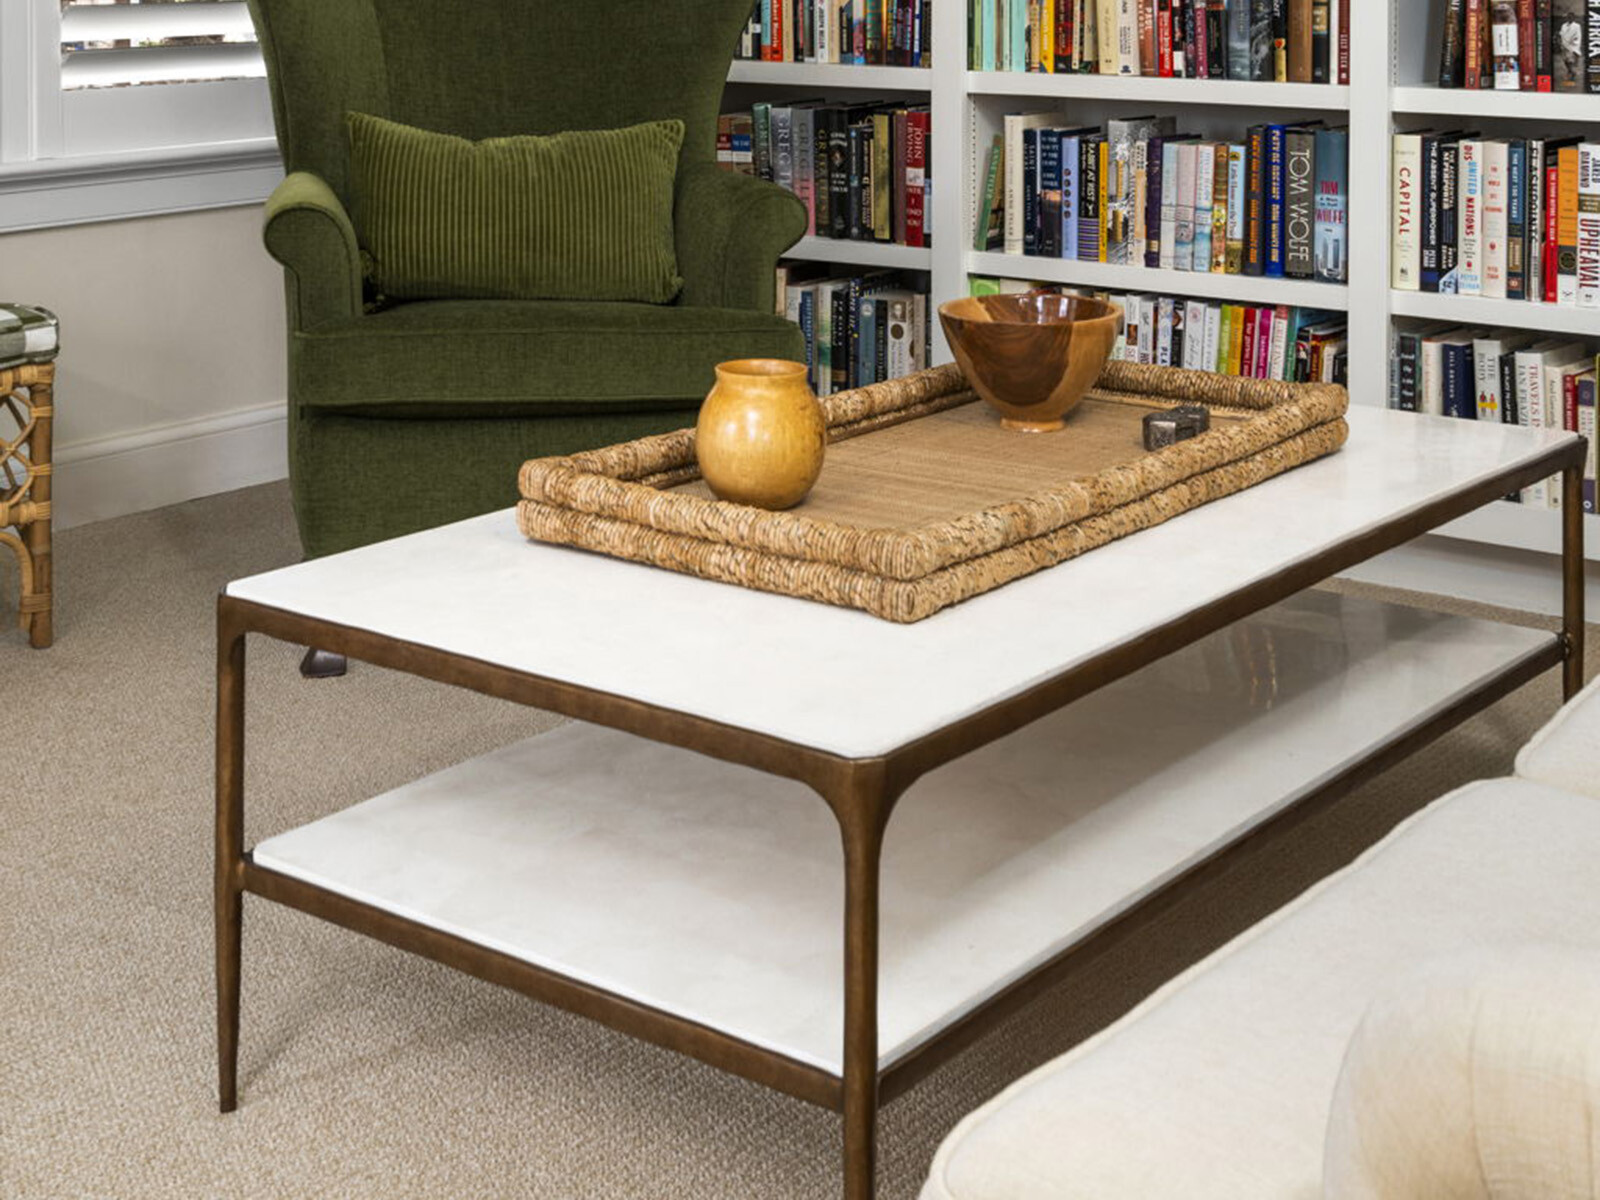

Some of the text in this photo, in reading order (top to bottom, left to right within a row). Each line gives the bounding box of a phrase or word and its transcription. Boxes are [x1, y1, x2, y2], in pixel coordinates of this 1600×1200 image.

[1144, 6, 1152, 30] PAUL
[915, 126, 924, 160] JOHN
[1430, 142, 1438, 158] THE
[1430, 158, 1438, 191] ABSENT
[1288, 148, 1310, 262] TOM WOLFE
[1399, 167, 1411, 235] CAPITAL
[1464, 196, 1476, 236] NATIONS
[1579, 218, 1600, 290] UPHEAVAL
